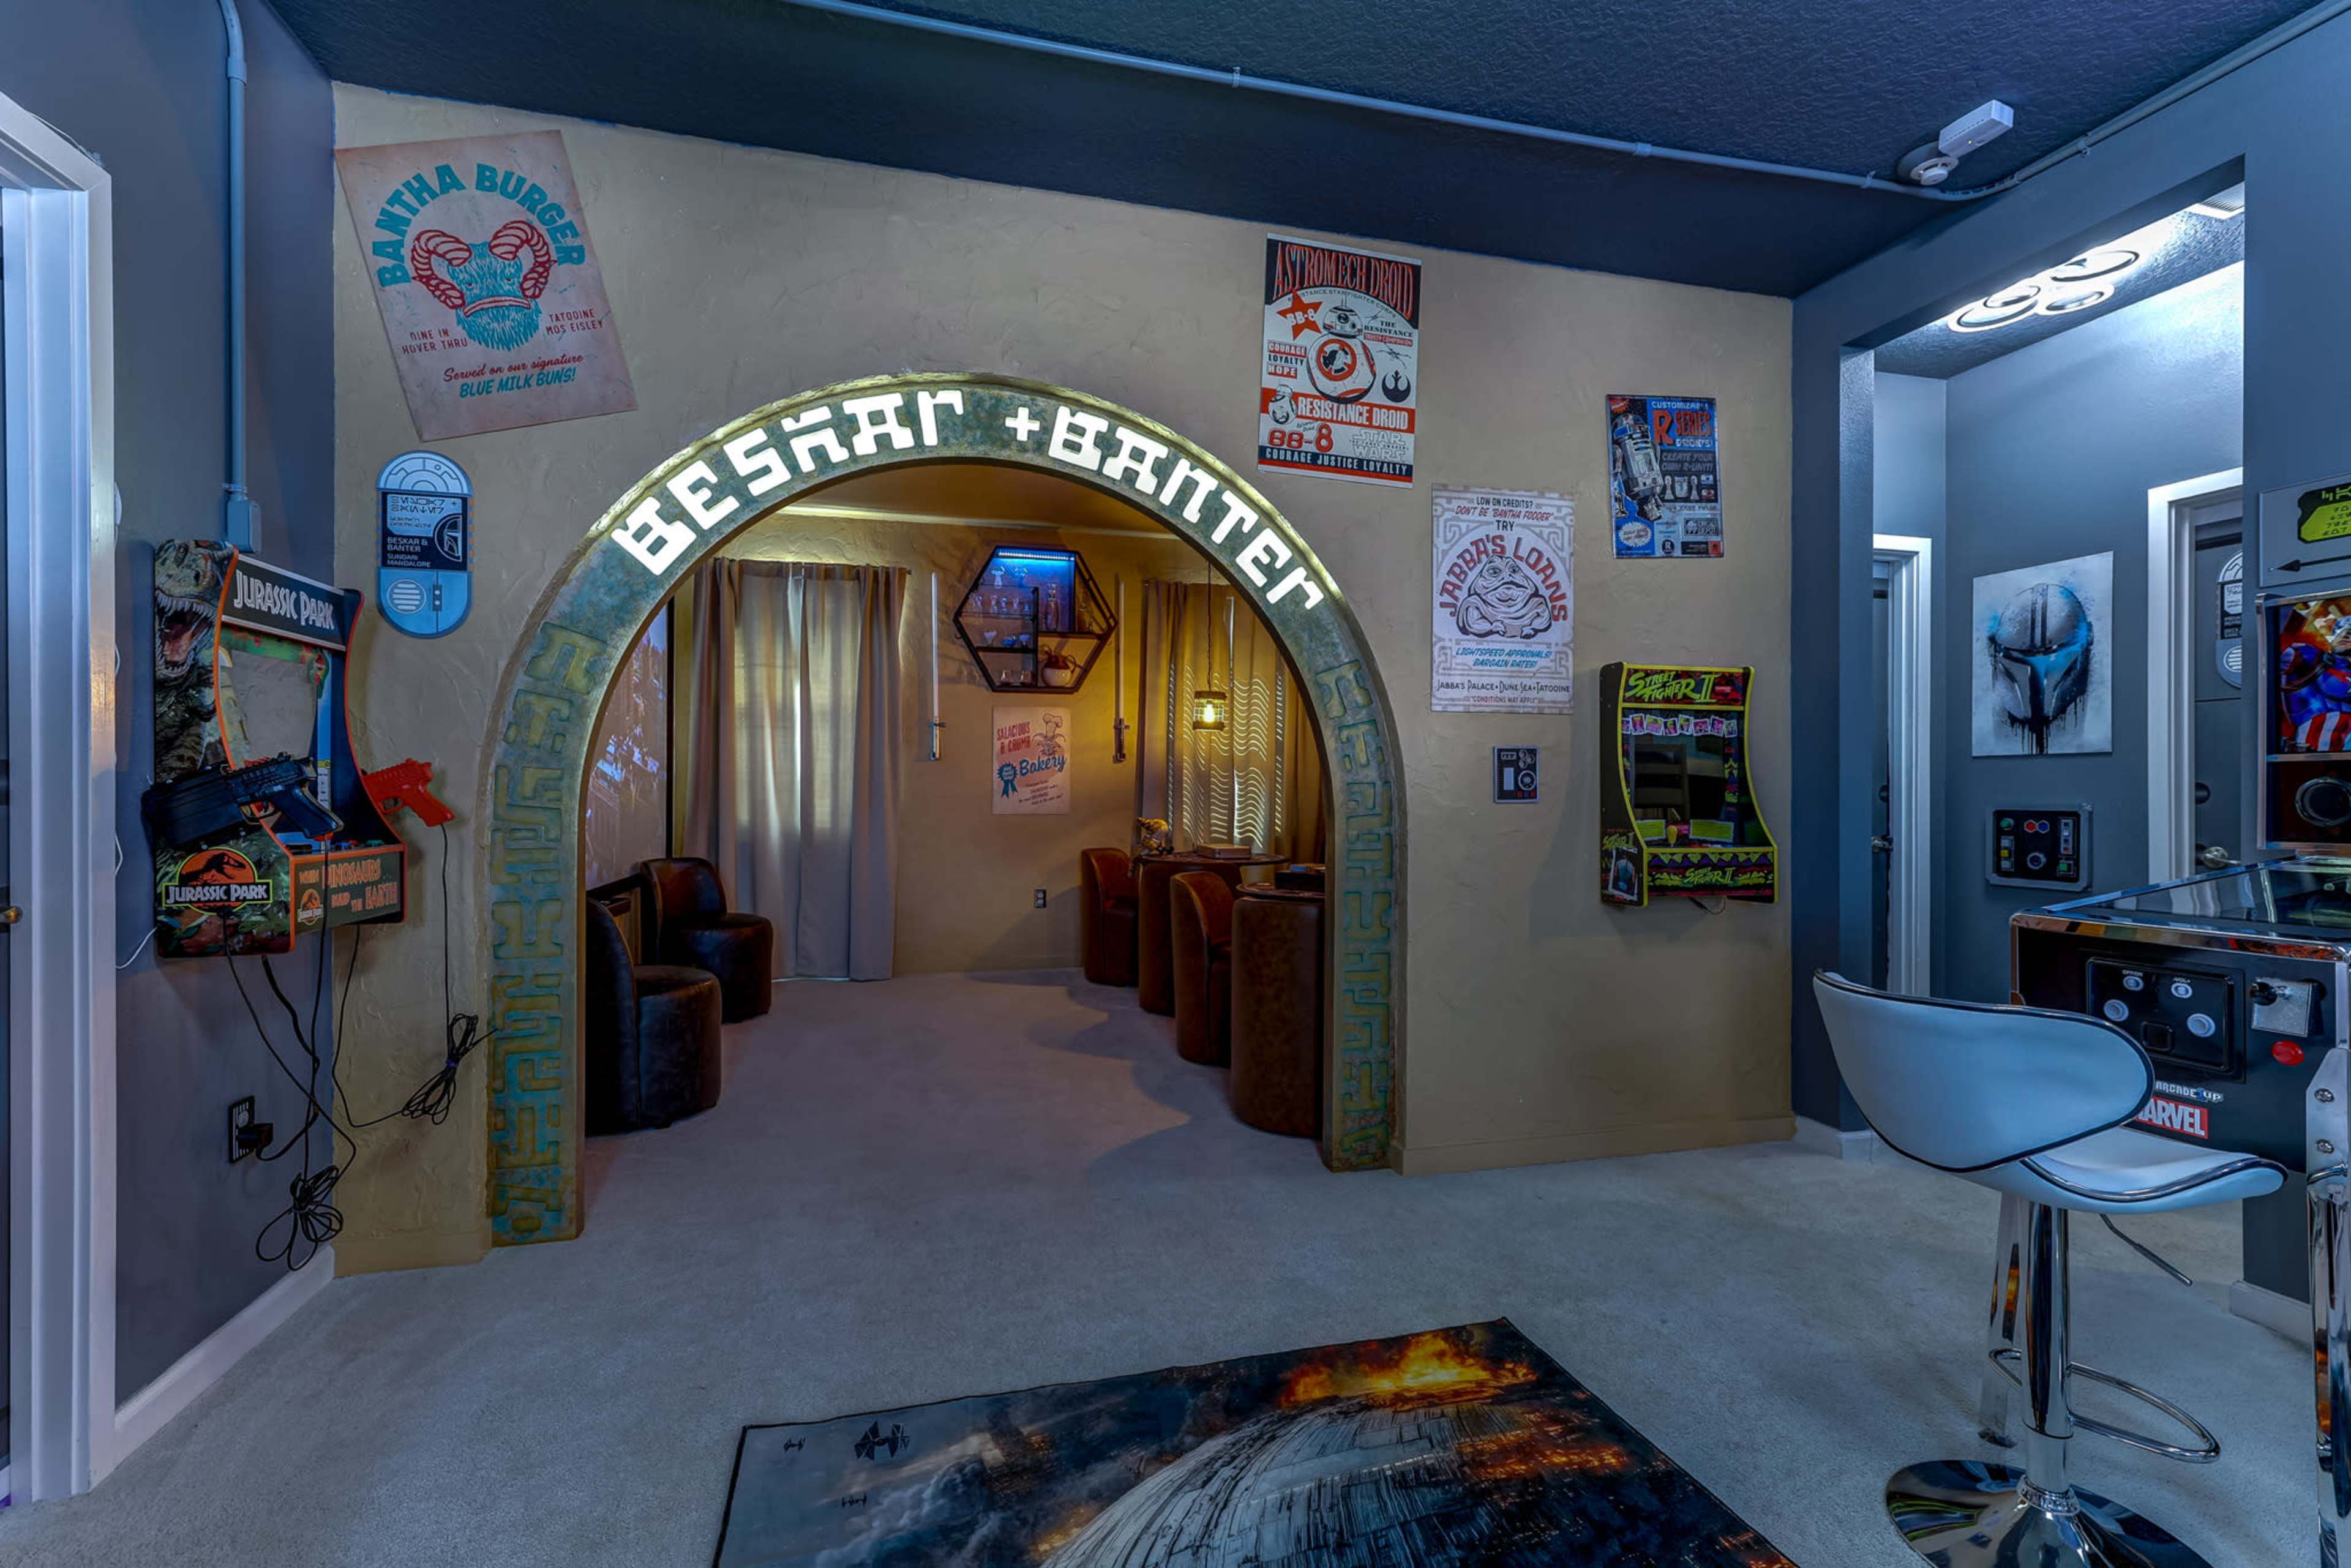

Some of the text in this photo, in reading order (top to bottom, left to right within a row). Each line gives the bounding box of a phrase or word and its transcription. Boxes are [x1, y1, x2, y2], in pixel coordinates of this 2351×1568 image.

[372, 163, 585, 287] BANTHA BURGER
[1273, 241, 1414, 320] ASTROMECH DROID
[439, 328, 449, 338] IN
[546, 320, 604, 335] MOS EISLEY
[1364, 325, 1413, 337] RESISTANCE
[402, 337, 468, 354] HOVER THRU
[1269, 342, 1305, 356] COURAGE
[443, 353, 584, 383] Served on our signature
[1268, 353, 1304, 366] LOYALTY
[1268, 365, 1296, 377] HOPE
[459, 367, 577, 399] BLUE MILK BUNS!
[1297, 397, 1409, 430] RESISTANCE DROID
[1652, 410, 1712, 445] R SERIES
[1352, 429, 1406, 446] STAR
[1352, 444, 1406, 462] WARS
[1265, 449, 1407, 476] COURAGE JUSTICE LOYALTY
[611, 389, 964, 576] BESKAR
[1048, 405, 1324, 610] BANTER
[1477, 497, 1491, 506] LOW
[1502, 498, 1533, 509] CREDITS?
[1479, 508, 1490, 517] BE
[1496, 520, 1515, 532] TRY
[387, 544, 421, 552] BANTER
[388, 537, 420, 546] BESKAR
[1439, 534, 1569, 621] JABBA'S LOANS
[233, 569, 335, 631] JURASSIC PARK
[1456, 647, 1505, 657] LIGHTSPEED
[1472, 658, 1510, 667] BARGAIN
[1625, 671, 1676, 697] STREET
[1640, 678, 1701, 702] FIGHTER
[997, 721, 1030, 741] SALACIOUS
[1008, 735, 1031, 754] CRUMB
[1019, 755, 1067, 776] Bakery
[166, 883, 268, 904] JURASSIC PARK
